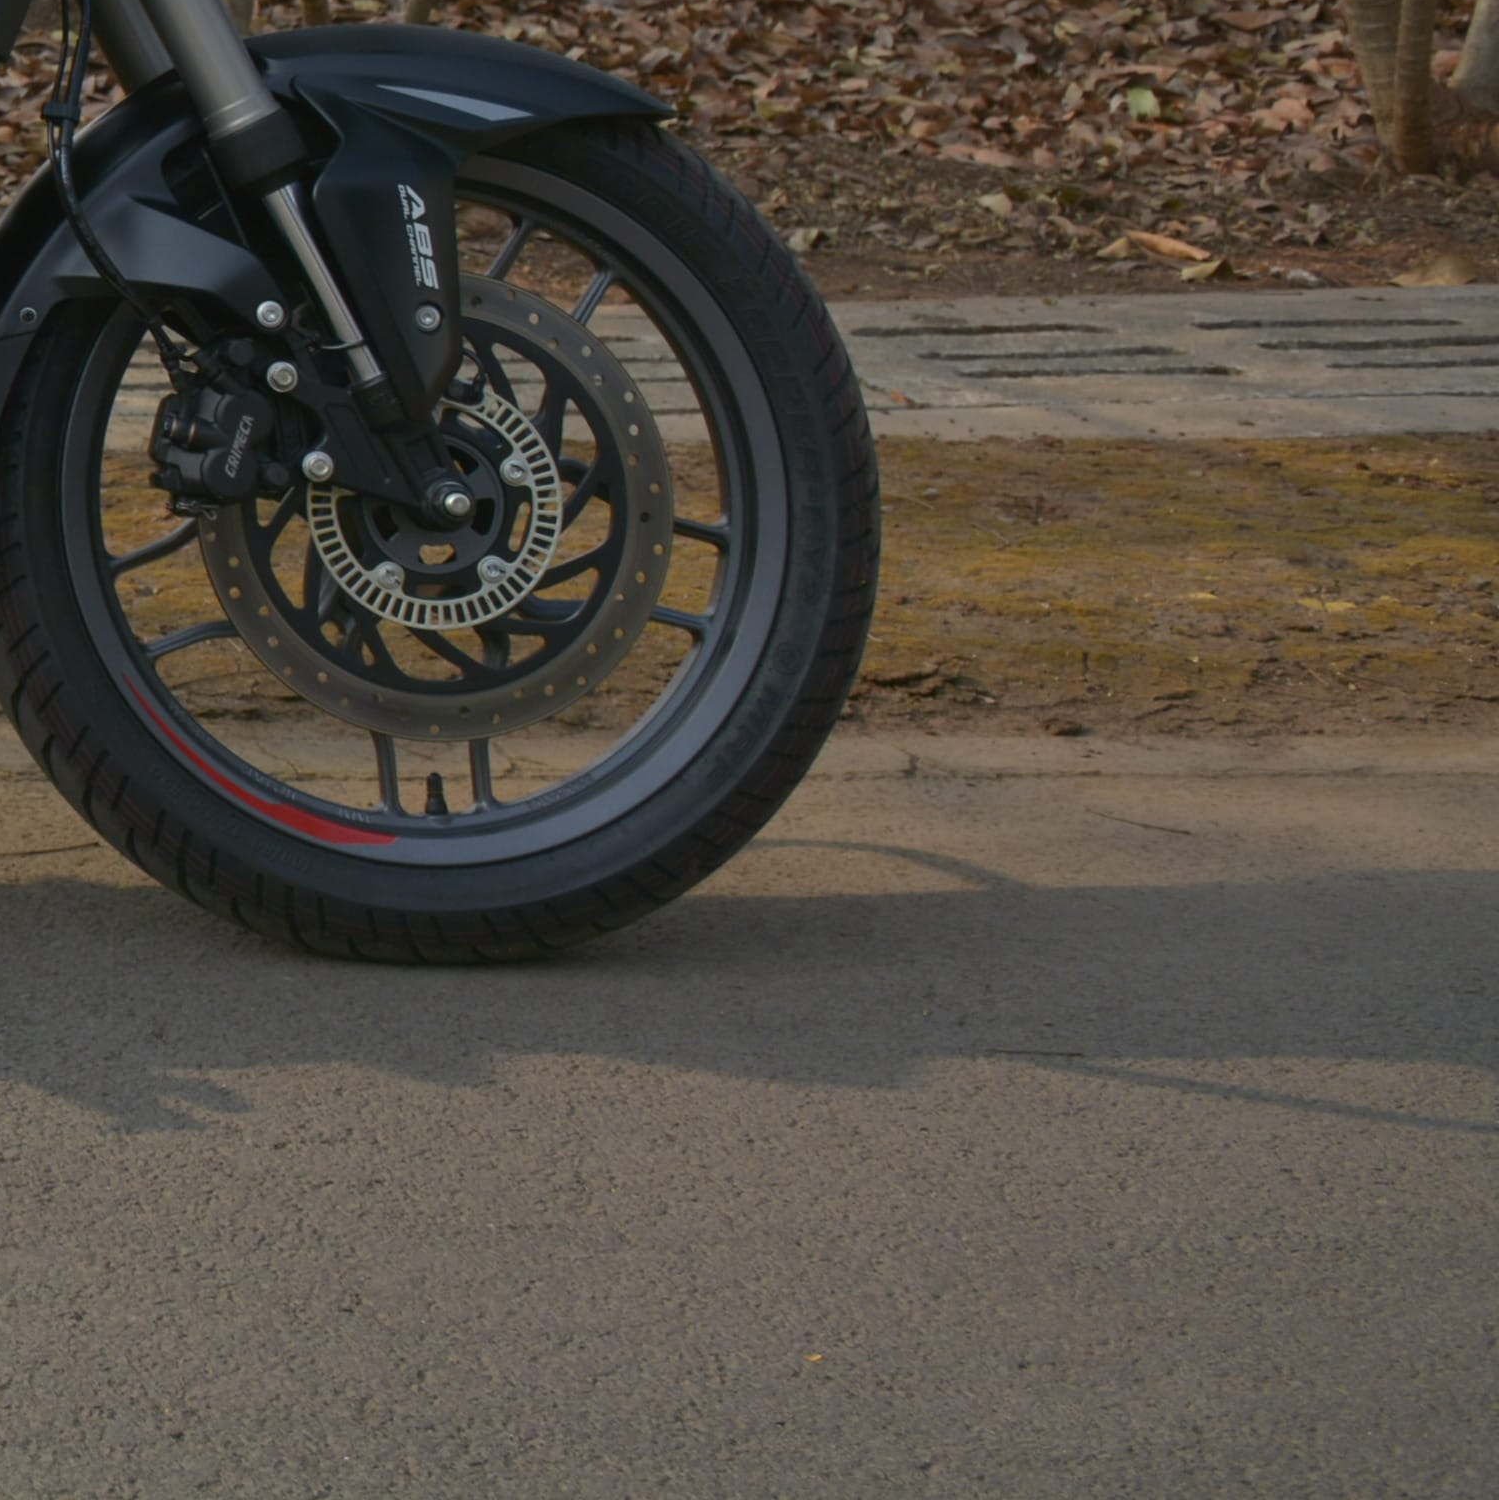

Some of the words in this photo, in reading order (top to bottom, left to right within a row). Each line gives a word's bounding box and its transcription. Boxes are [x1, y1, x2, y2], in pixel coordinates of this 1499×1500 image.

[397, 184, 411, 220] DUAL
[406, 223, 422, 287] CHANNEL
[406, 184, 439, 290] ABS
[224, 414, 255, 479] GRIMECA
